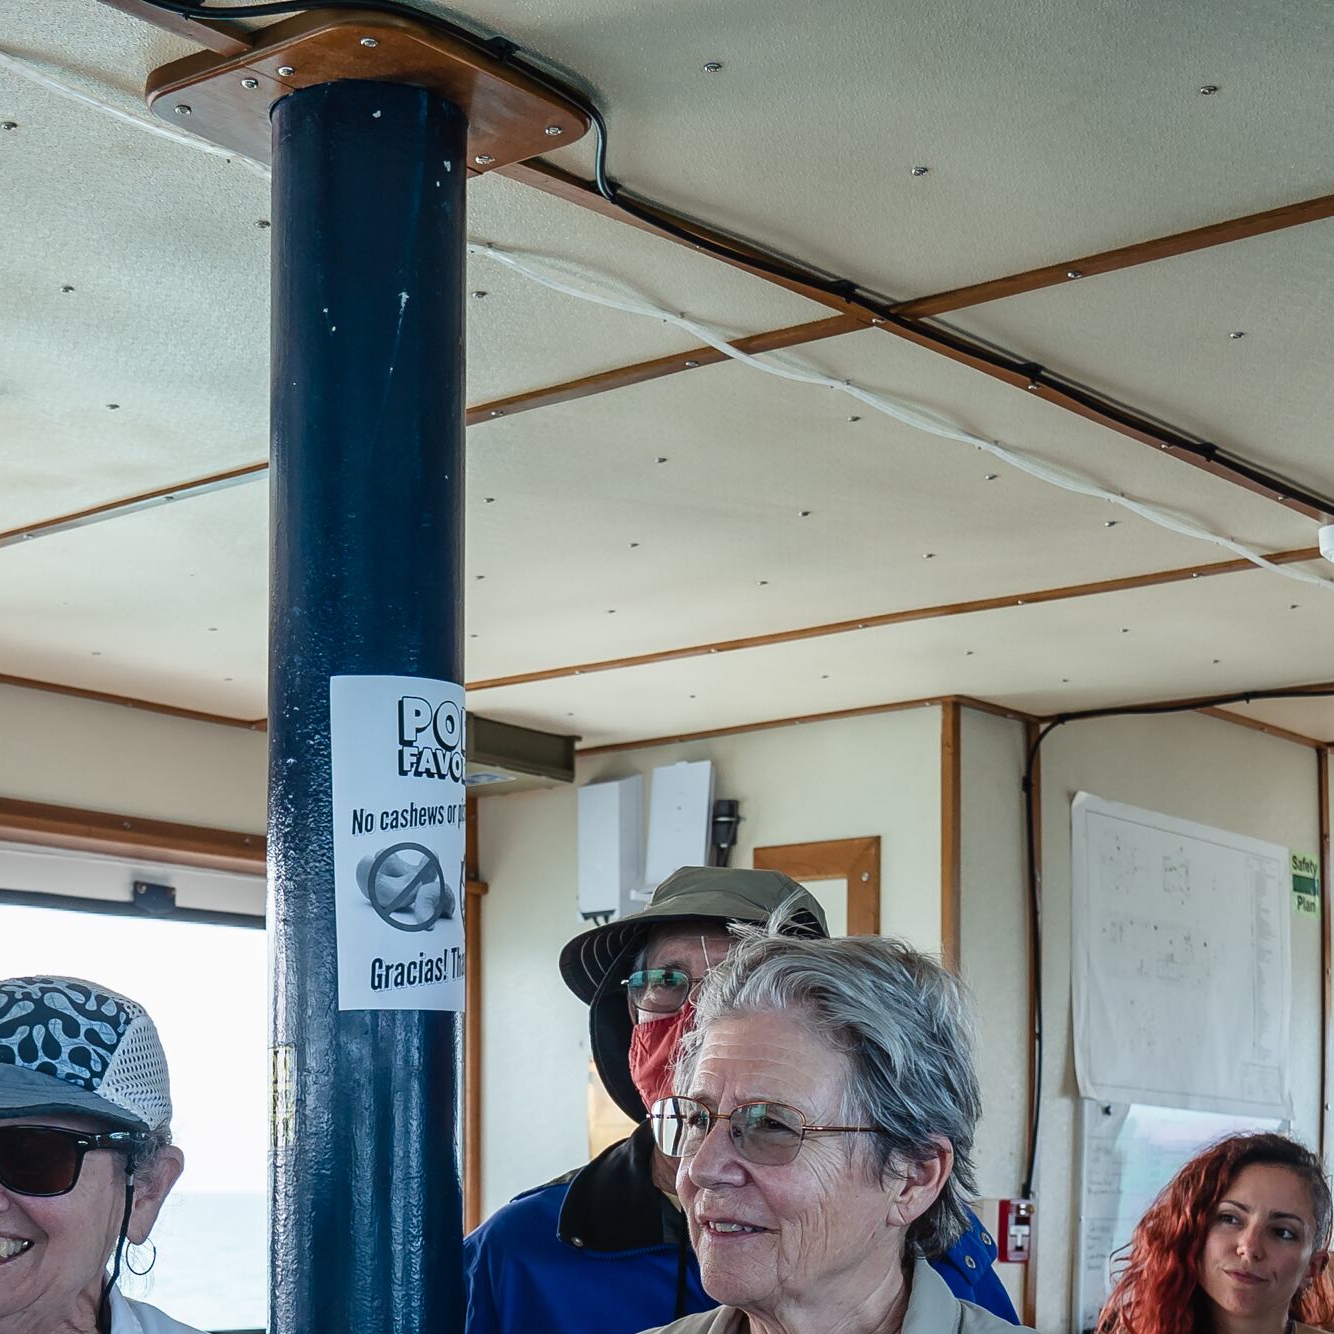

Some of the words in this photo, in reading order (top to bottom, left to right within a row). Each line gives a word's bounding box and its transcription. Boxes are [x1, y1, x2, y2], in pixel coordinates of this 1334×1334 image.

[398, 696, 466, 752] PO
[398, 745, 466, 783] FAVO
[352, 808, 374, 835] No
[380, 802, 445, 830] cashews
[447, 804, 456, 823] or
[1292, 855, 1318, 879] Safety
[1297, 895, 1316, 912] Plan
[371, 949, 448, 990] Gracias!
